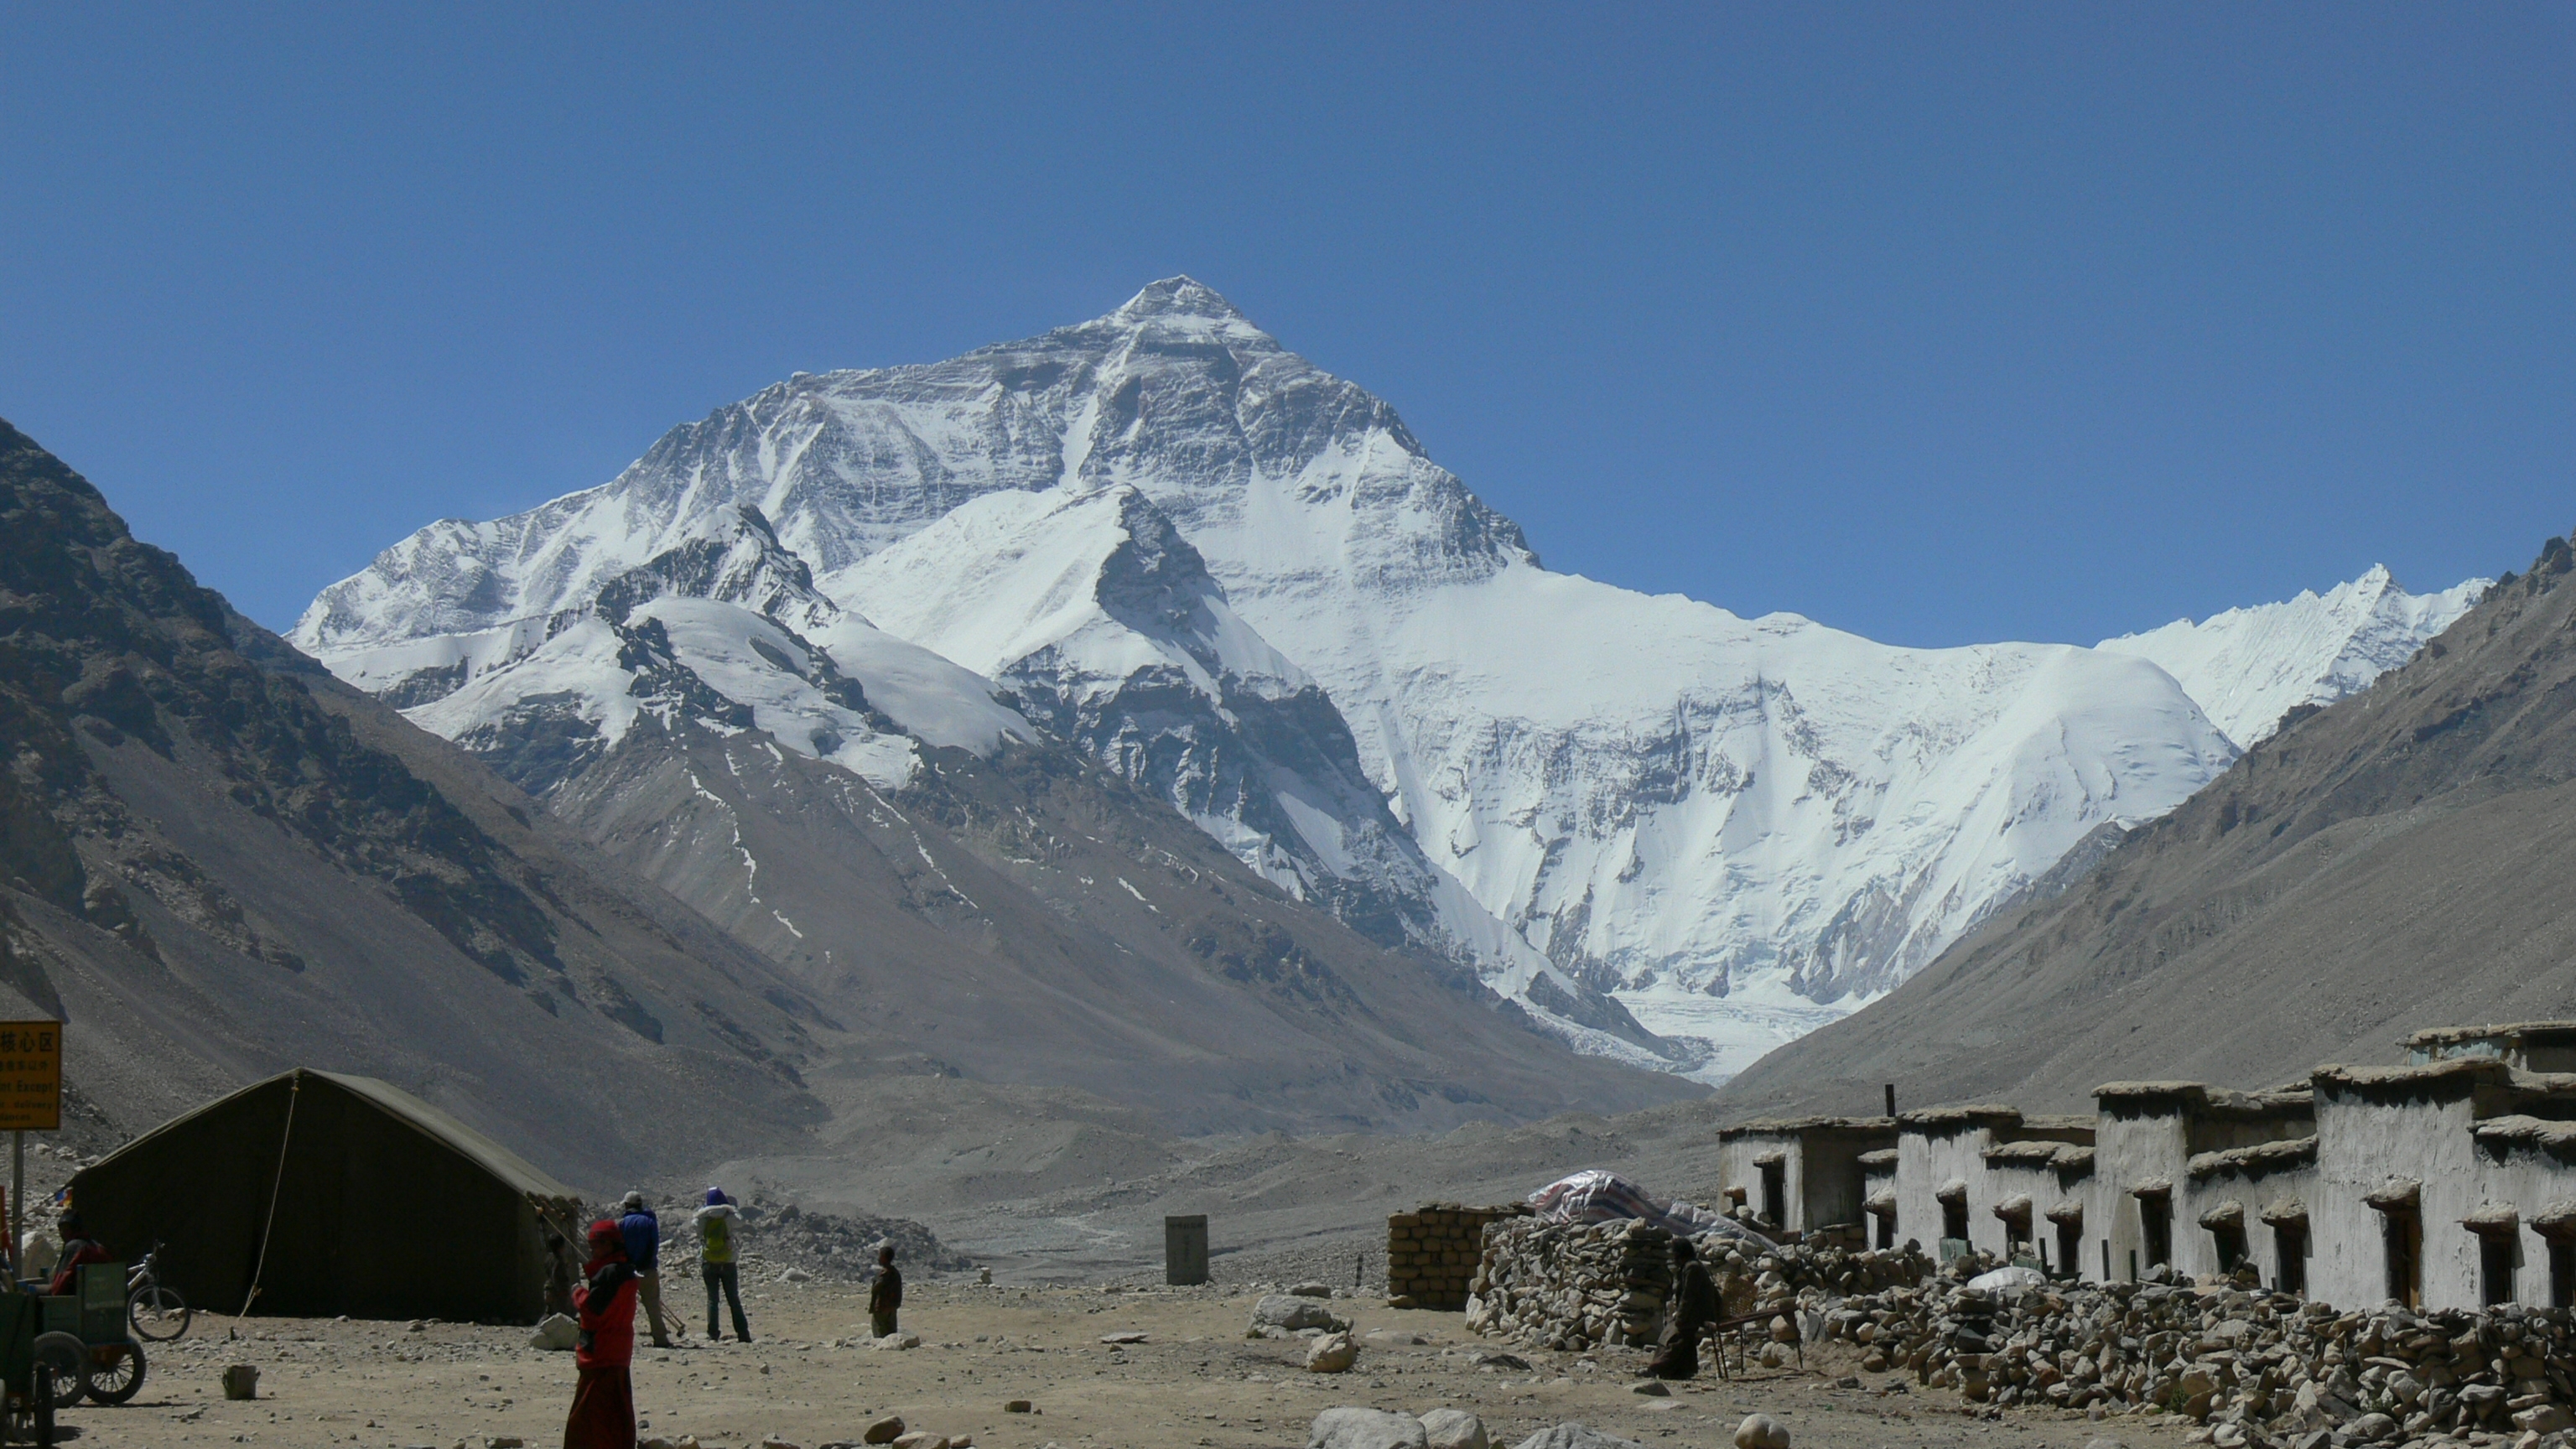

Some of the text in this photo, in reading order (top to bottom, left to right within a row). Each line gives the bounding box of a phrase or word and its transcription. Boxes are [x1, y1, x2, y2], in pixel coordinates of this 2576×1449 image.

[0, 1031, 53, 1052] 核心区
[18, 1080, 53, 1093] Except
